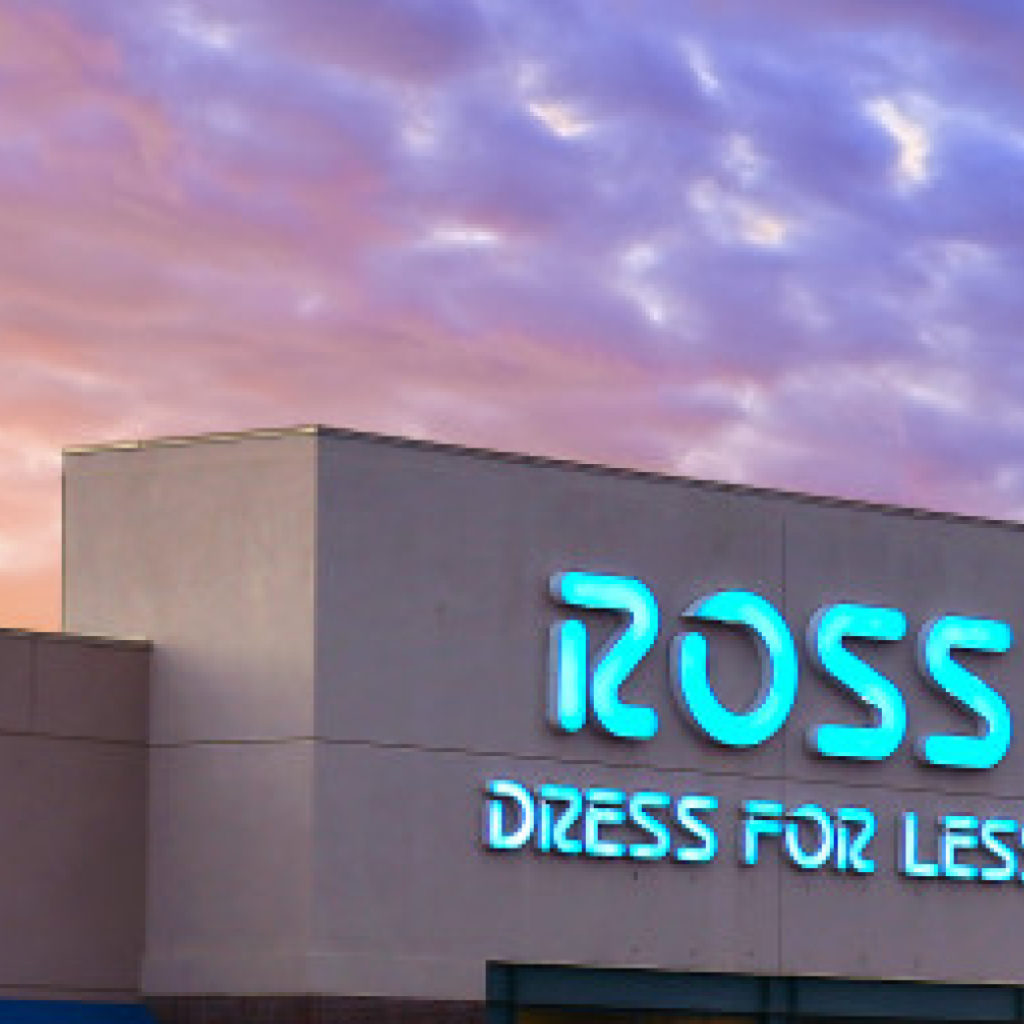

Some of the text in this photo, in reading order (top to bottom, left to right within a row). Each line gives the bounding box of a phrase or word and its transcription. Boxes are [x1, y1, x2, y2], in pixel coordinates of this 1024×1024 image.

[549, 571, 1012, 769] ROSS
[485, 779, 719, 862] DRESS
[742, 799, 876, 874] FOR
